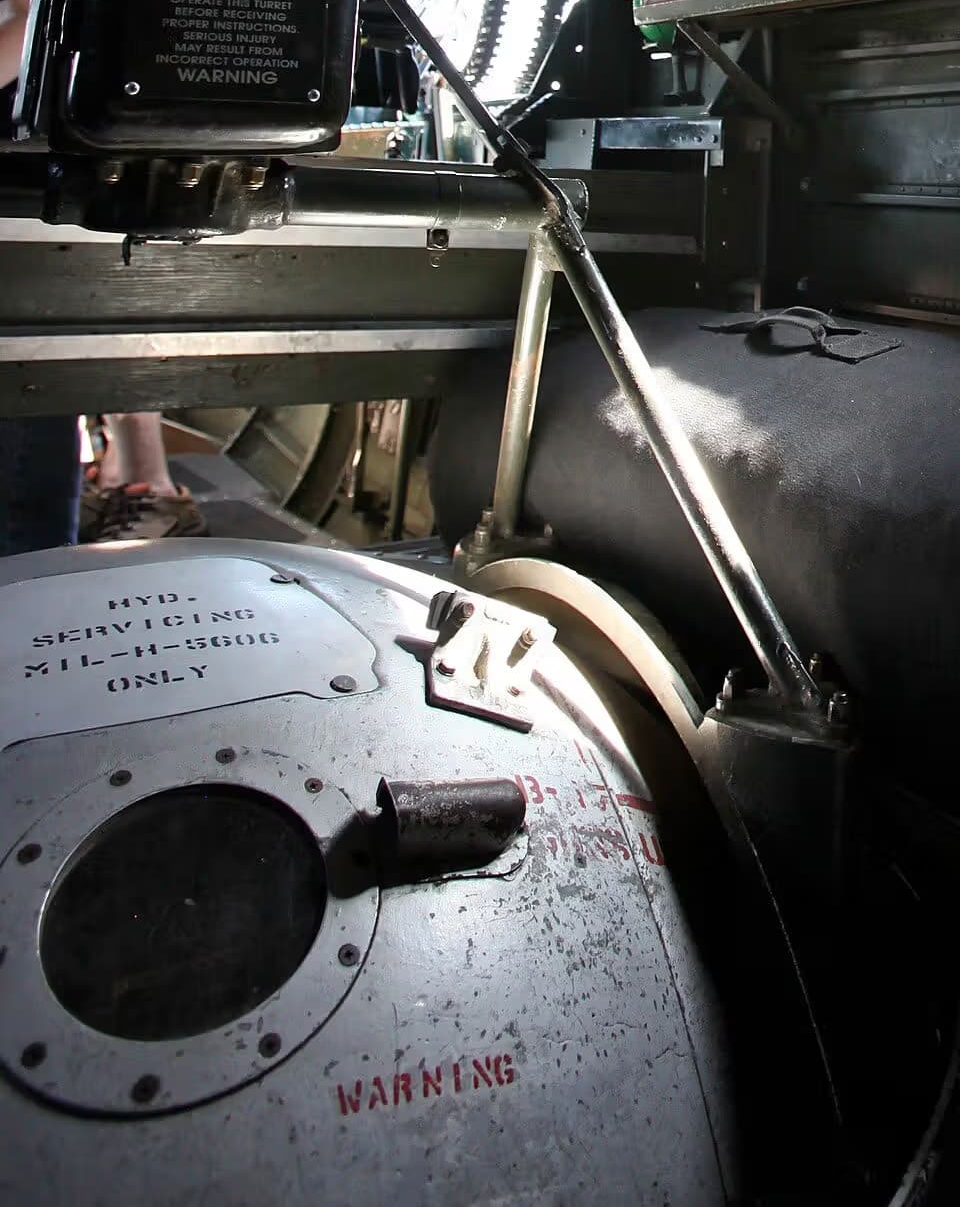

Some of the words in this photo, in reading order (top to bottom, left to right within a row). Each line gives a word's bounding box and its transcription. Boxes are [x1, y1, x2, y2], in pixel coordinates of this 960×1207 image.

[254, 0, 292, 10] TURRET
[175, 6, 219, 18] BEFORE
[223, 9, 287, 22] RECEIVING
[162, 18, 209, 29] PROPER
[183, 31, 232, 42] SERIOUS
[236, 33, 277, 44] INJURY
[175, 42, 202, 53] MAY
[206, 44, 245, 55] RESULT
[249, 46, 283, 56] FROM
[155, 53, 228, 66] INCORRECT
[232, 57, 299, 69] OPERATION
[177, 67, 279, 85] WARNING
[32, 608, 255, 648] SERVICING
[25, 632, 280, 678] MIL-H-5606
[107, 665, 208, 692] ONLY
[337, 1054, 516, 1115] WARNING
